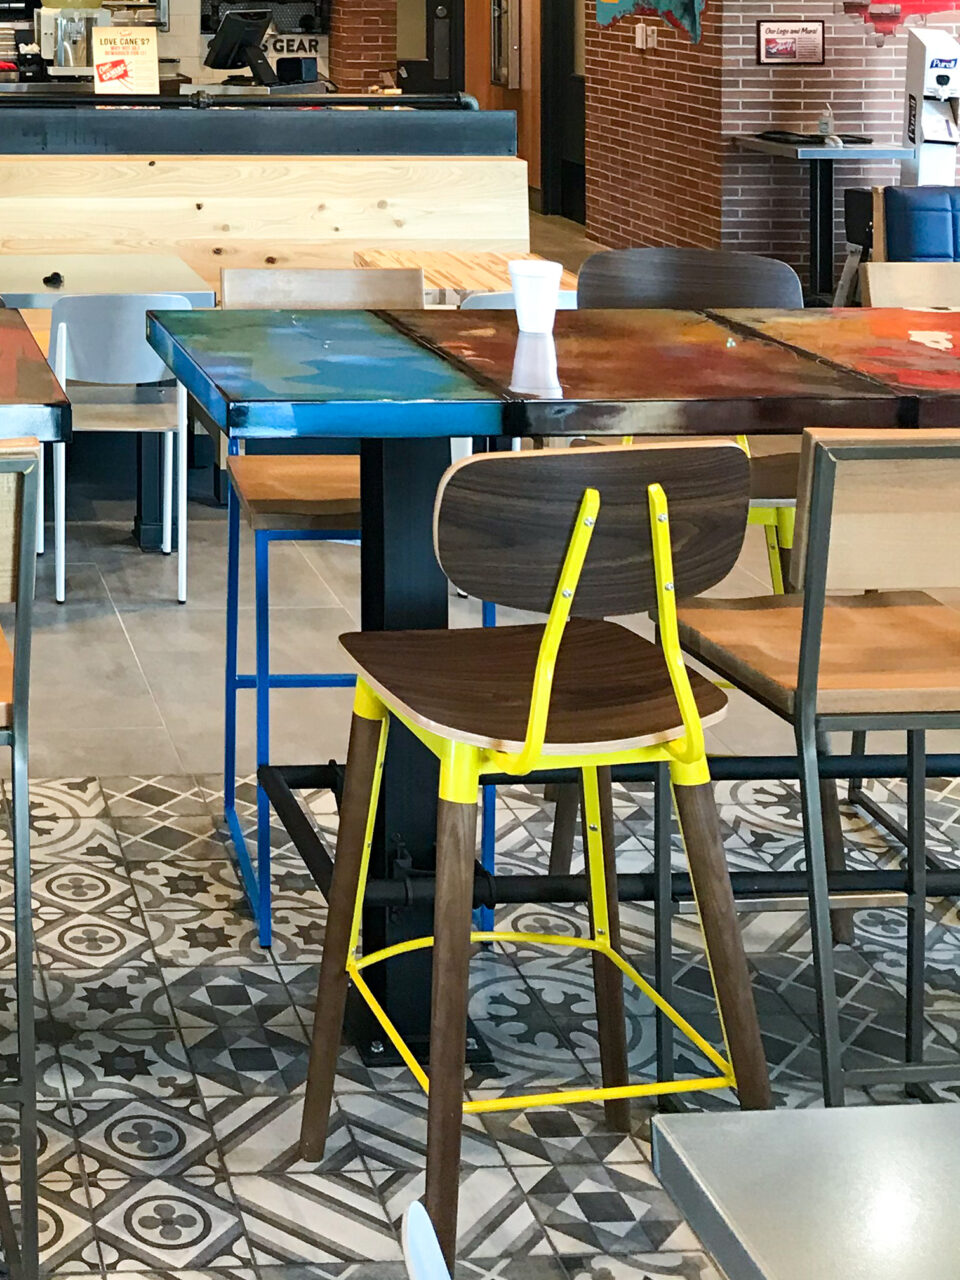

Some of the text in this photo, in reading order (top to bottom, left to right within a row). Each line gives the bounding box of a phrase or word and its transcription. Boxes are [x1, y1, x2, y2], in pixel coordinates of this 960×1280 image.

[765, 27, 777, 35] Our
[801, 27, 818, 35] Mural
[100, 38, 150, 46] LOVE CANE'S?
[272, 39, 319, 53] GEAR
